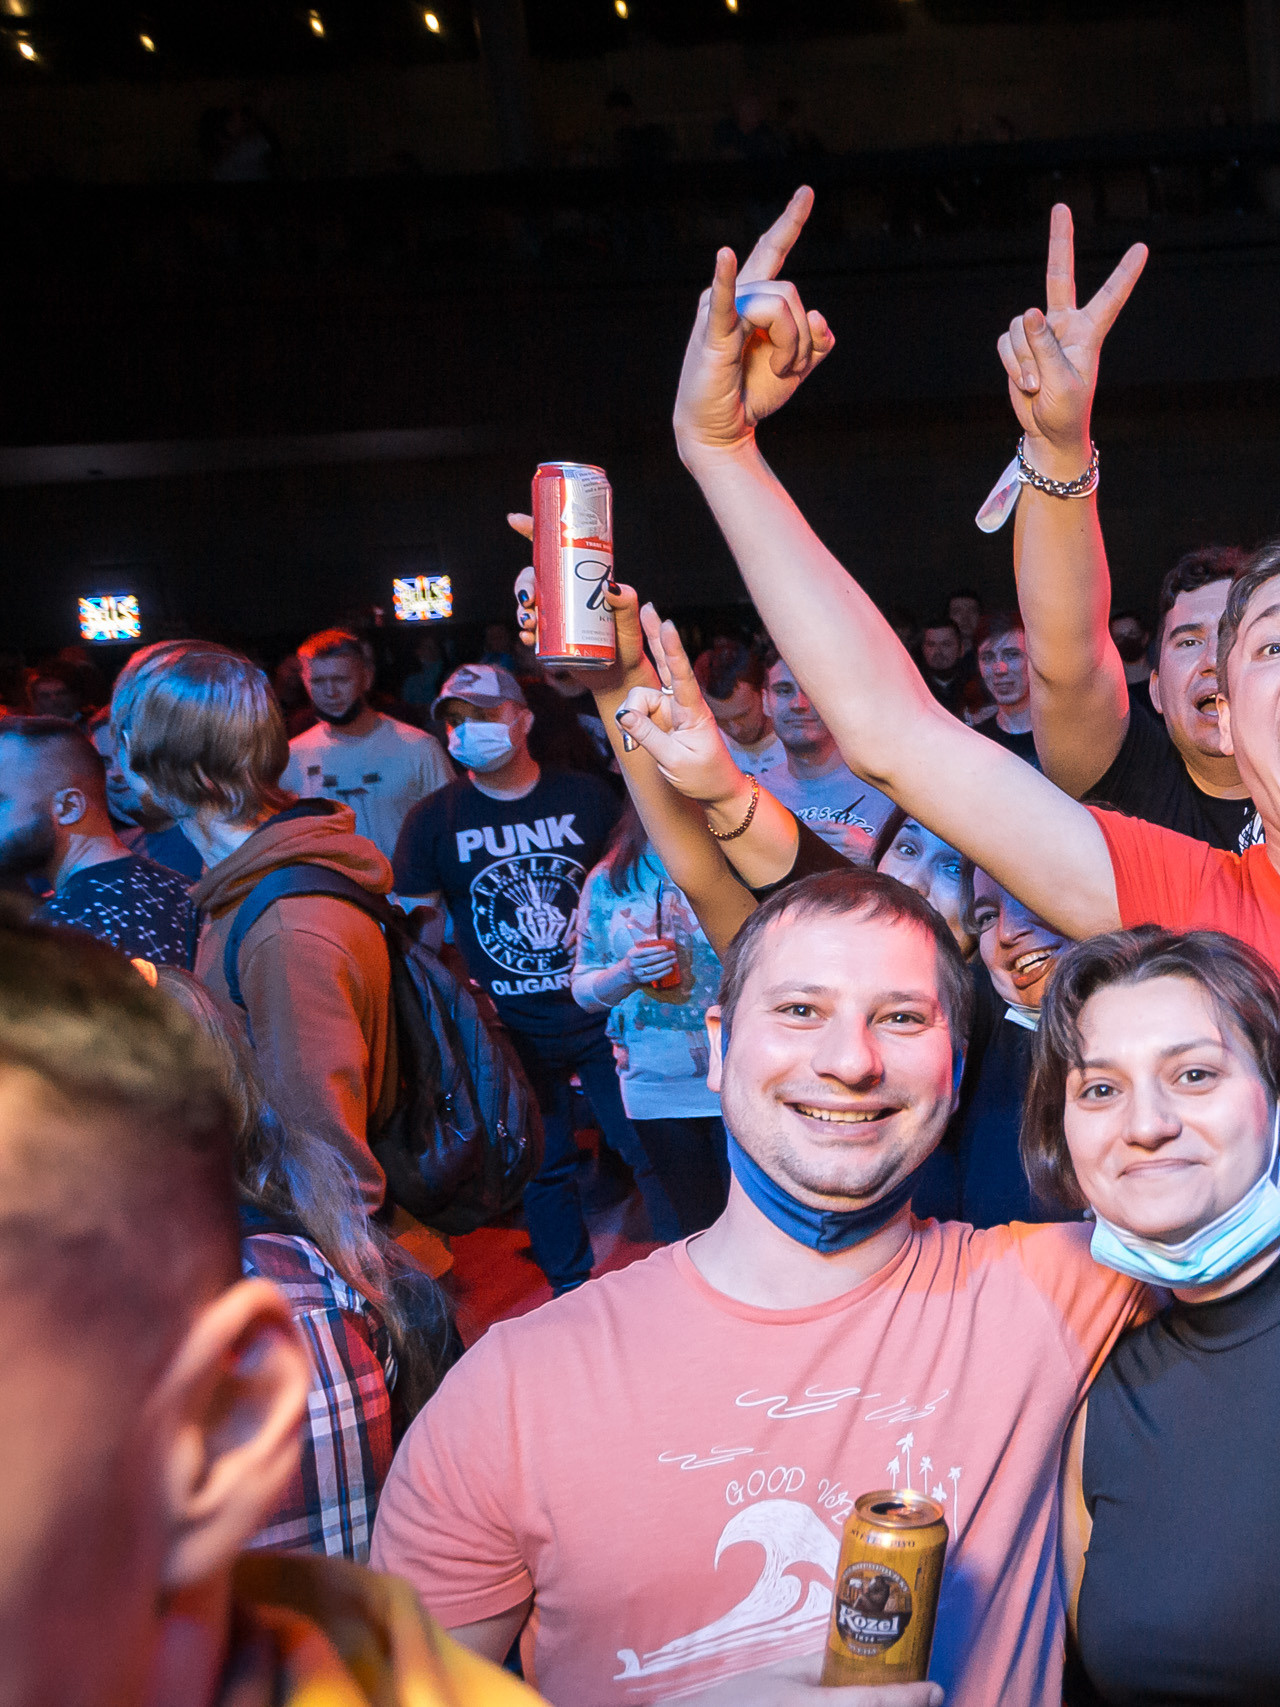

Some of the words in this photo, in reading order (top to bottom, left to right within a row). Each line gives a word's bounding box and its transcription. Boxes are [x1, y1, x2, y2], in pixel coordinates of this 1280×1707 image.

[456, 813, 585, 863] PUNK
[481, 932, 552, 972] SINCE
[725, 1466, 805, 1506] GOOD
[838, 1603, 899, 1635] Kozel
